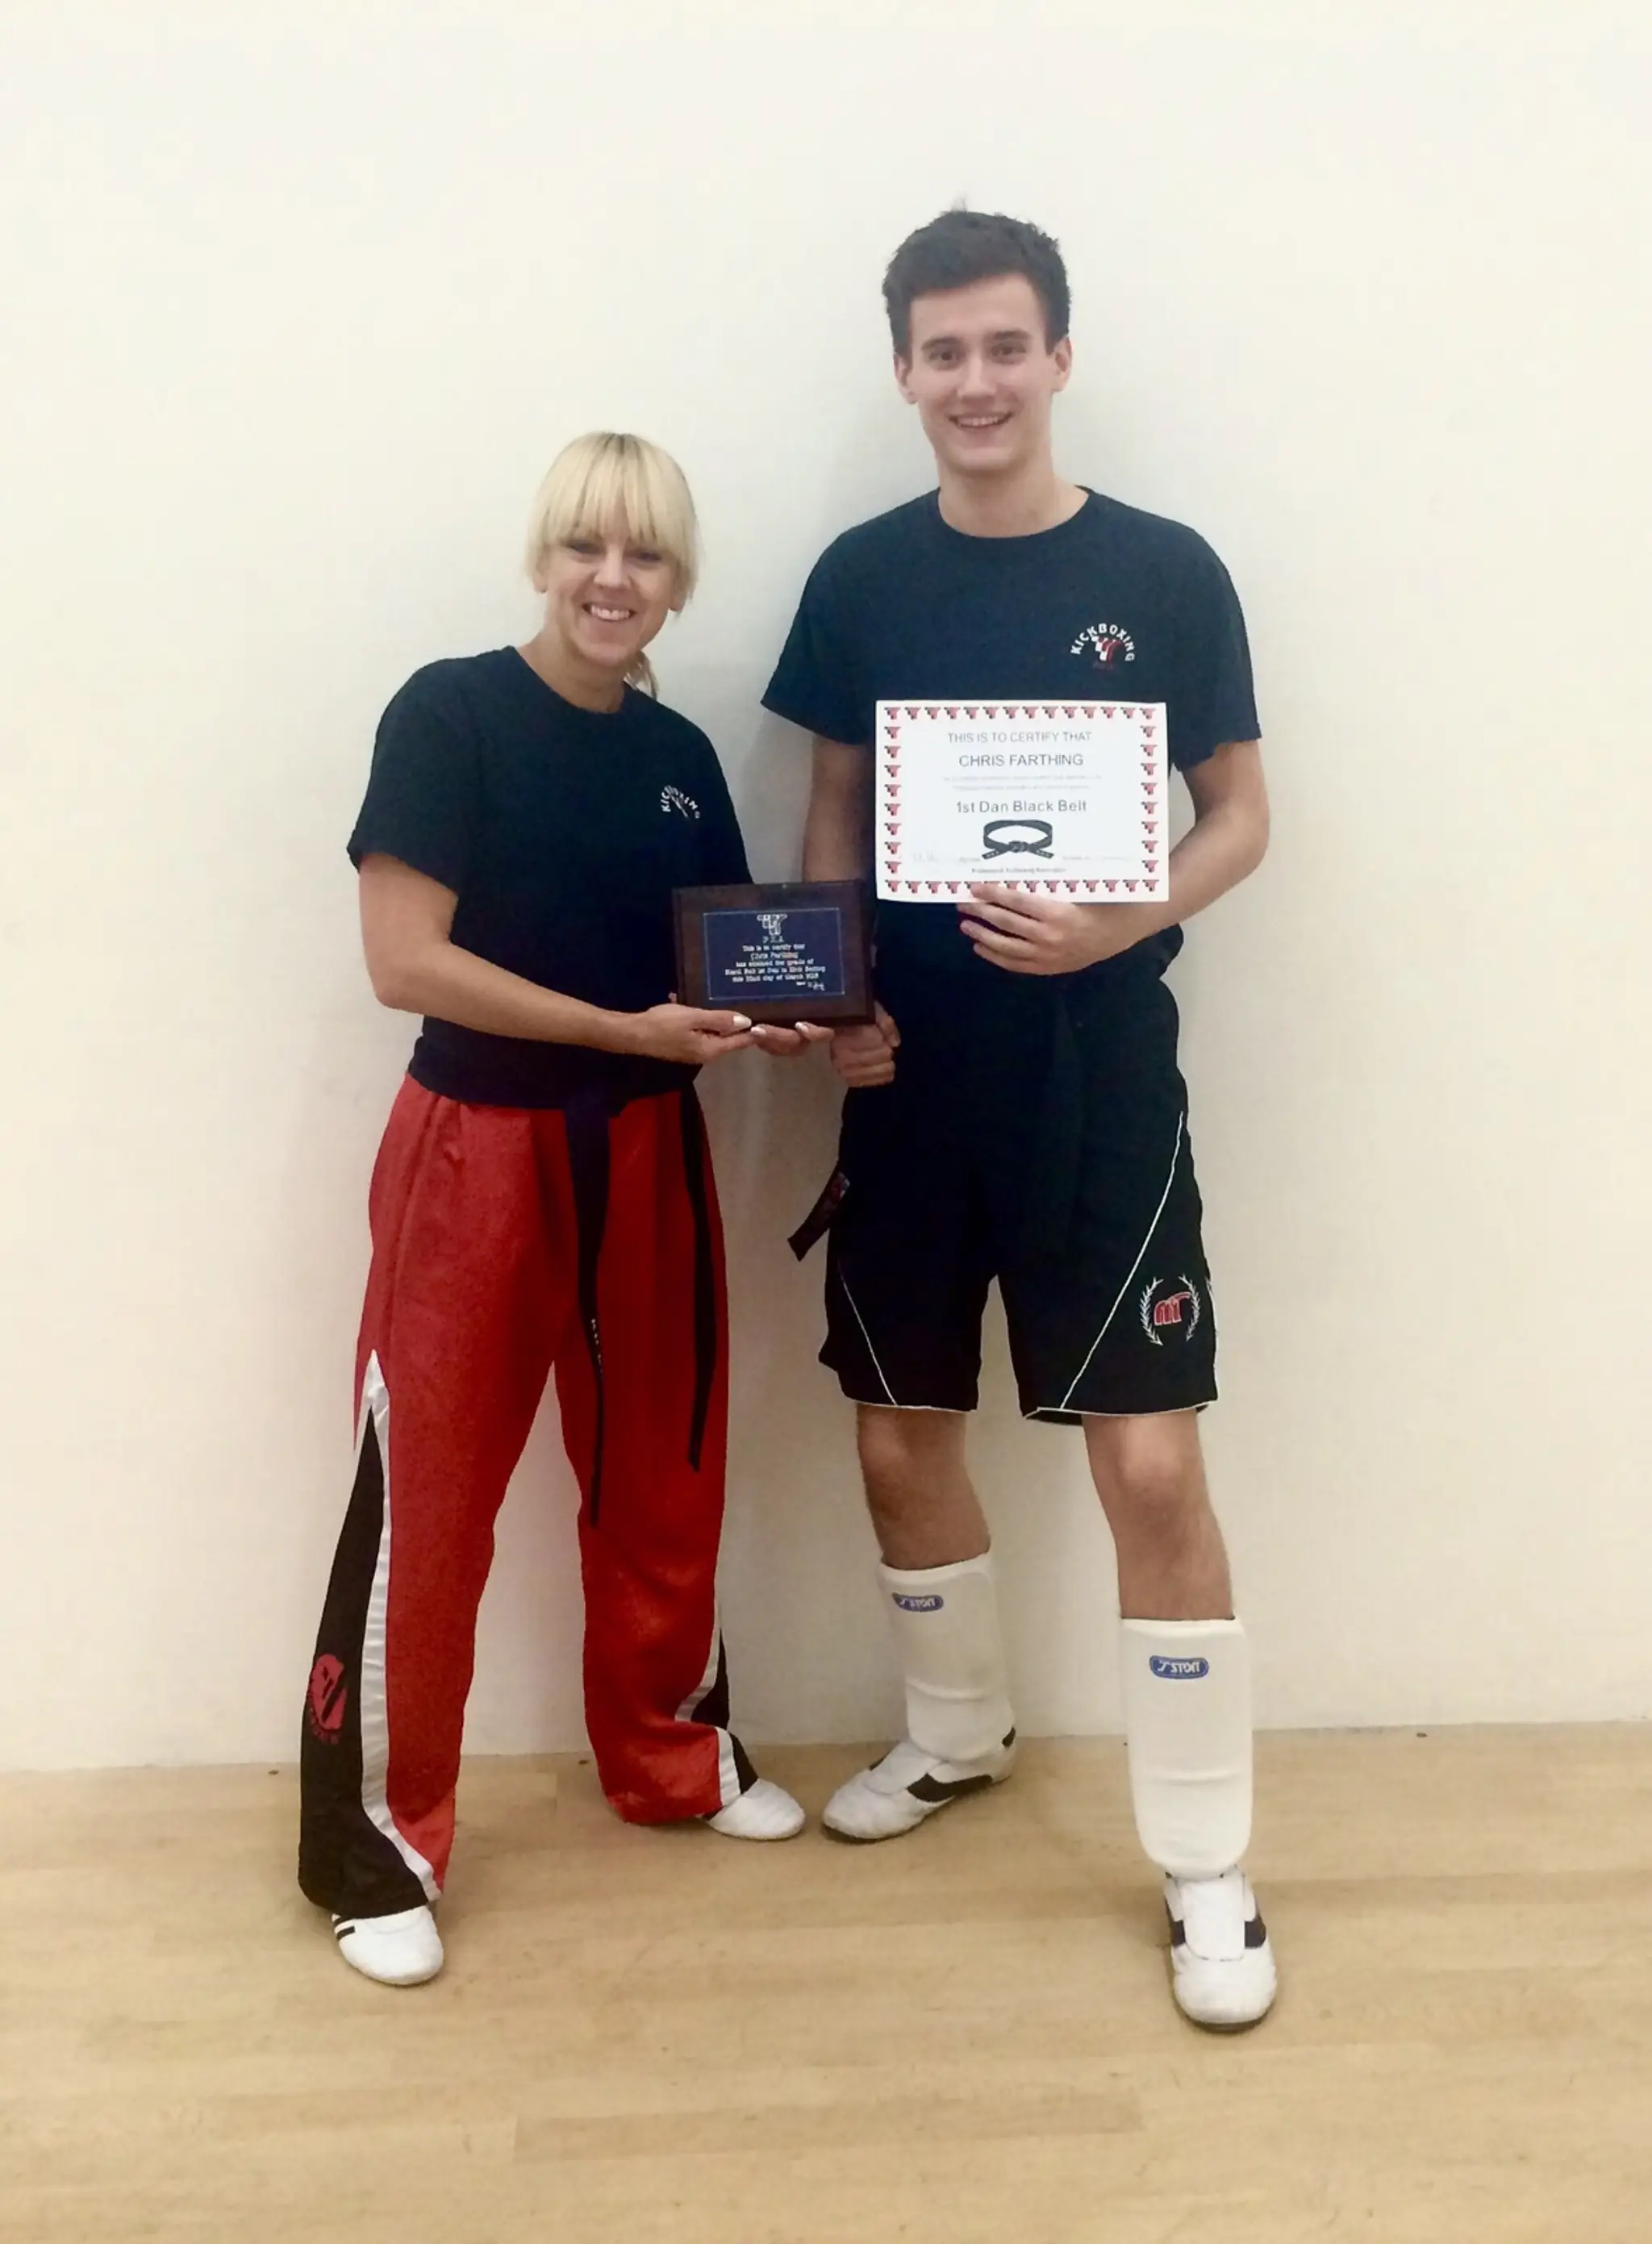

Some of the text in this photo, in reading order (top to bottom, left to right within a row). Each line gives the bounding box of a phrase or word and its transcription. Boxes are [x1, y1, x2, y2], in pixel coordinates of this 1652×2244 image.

[1070, 622, 1136, 661] KICKBOXING
[948, 731, 1092, 743] THIS IS TO CERTIFY THAT
[958, 753, 1084, 767] CHRIS FARTHING
[956, 799, 1087, 813] 1st Dan Black Belt
